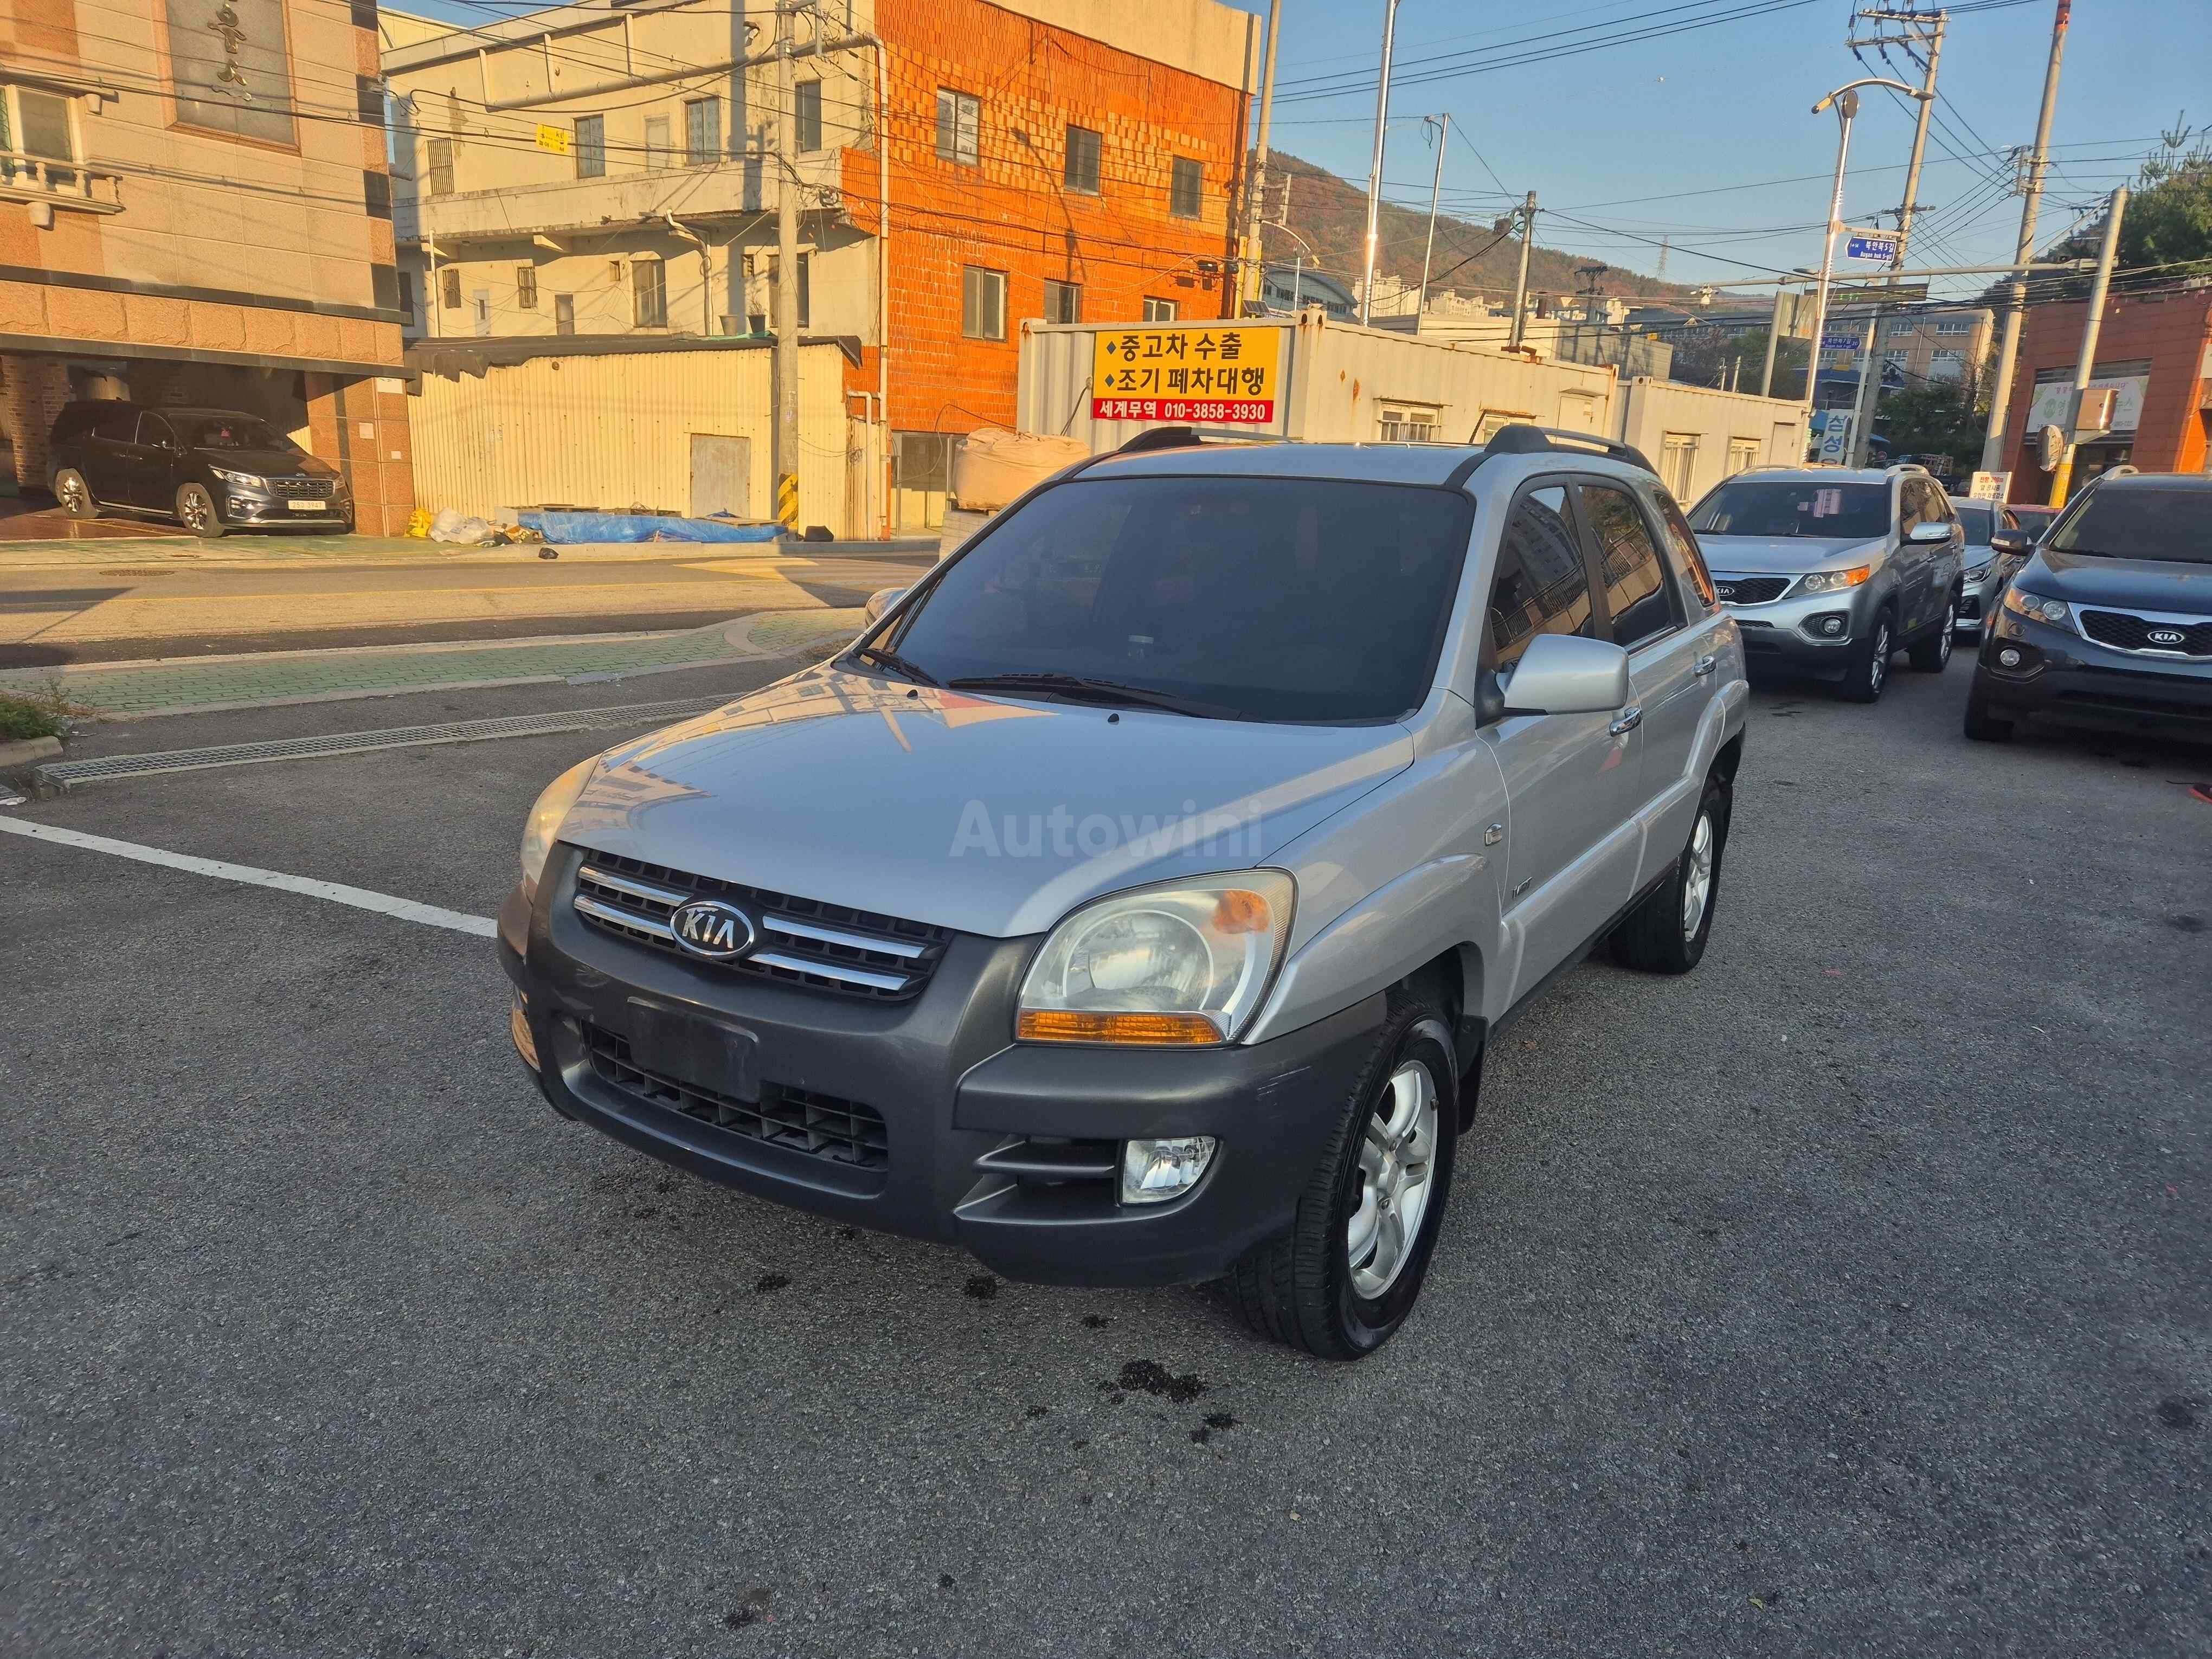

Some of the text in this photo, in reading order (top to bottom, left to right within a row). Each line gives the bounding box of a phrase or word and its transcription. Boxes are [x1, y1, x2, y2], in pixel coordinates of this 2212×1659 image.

[1866, 241, 1894, 253] 북안북5길
[1120, 332, 1242, 362] 중고차 수출
[1117, 367, 1265, 395] 조기 폐차대행
[1099, 401, 1265, 420] 세계무역 010-3858-3930
[1821, 415, 1848, 465] 삼성
[2155, 632, 2177, 641] KIA
[681, 906, 734, 949] KIA
